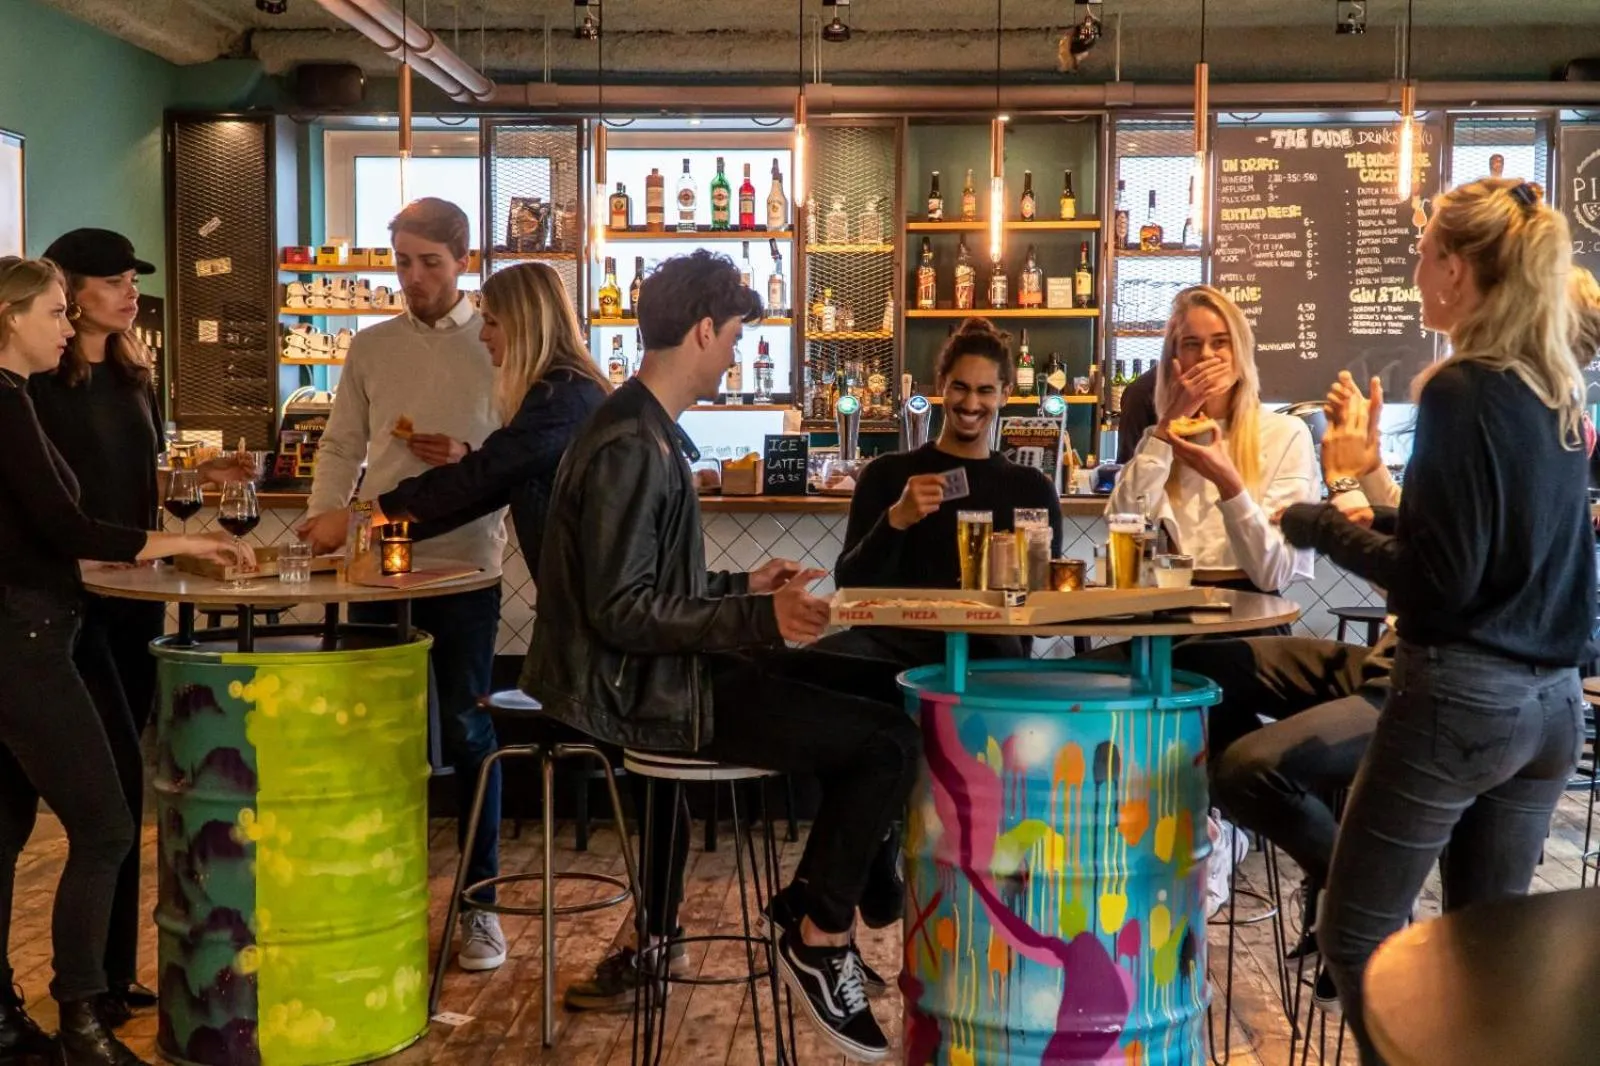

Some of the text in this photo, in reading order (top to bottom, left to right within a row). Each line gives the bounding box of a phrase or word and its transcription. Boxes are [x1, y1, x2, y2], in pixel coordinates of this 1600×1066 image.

[1270, 129, 1308, 149] THE
[1311, 128, 1355, 149] DUDE
[1355, 128, 1398, 145] DRINKS
[768, 439, 798, 452] ICE
[767, 458, 806, 471] LATTE
[838, 611, 873, 620] PIZZA
[902, 611, 937, 619] PIZZA
[966, 611, 1001, 619] PIZZA
